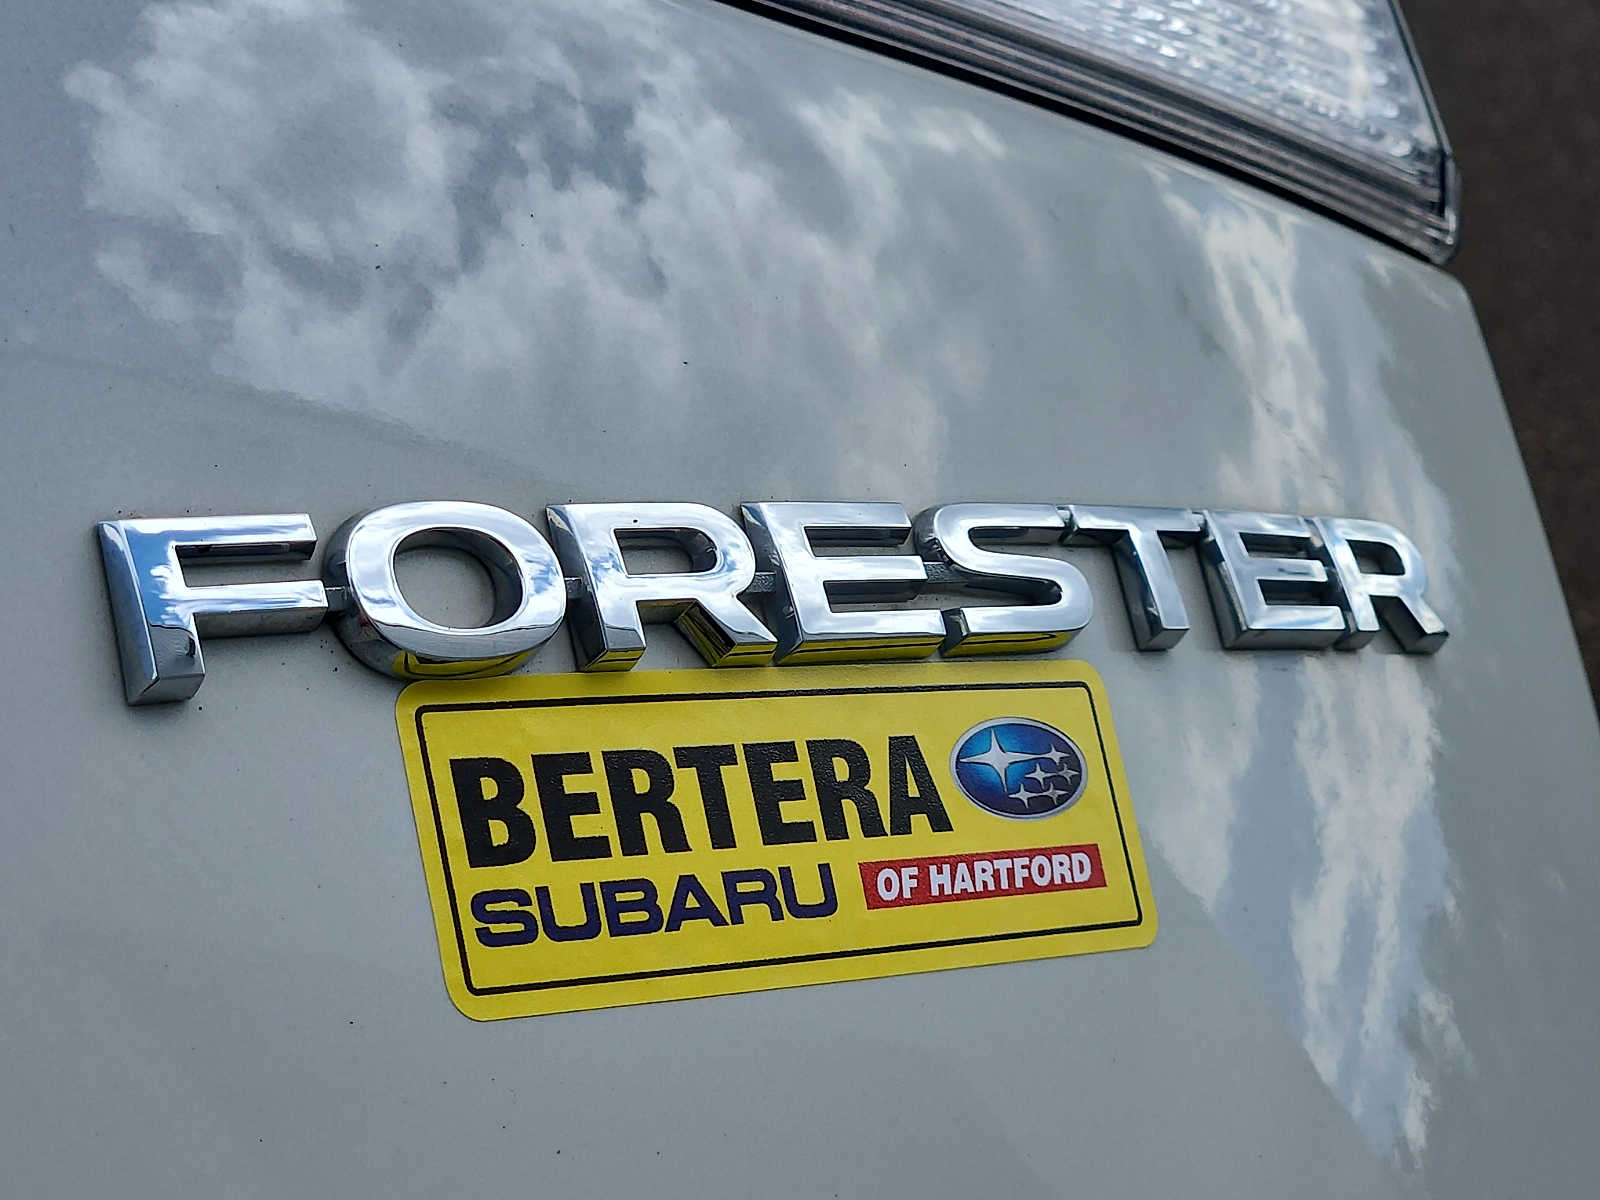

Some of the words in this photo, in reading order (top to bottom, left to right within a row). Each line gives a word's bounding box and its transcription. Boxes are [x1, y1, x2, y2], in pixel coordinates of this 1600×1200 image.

[98, 500, 1449, 706] FORESTER
[449, 735, 954, 869] BERTERA
[470, 862, 838, 948] SUBARU
[875, 865, 918, 902] OF
[926, 851, 1093, 897] HARTFORD
